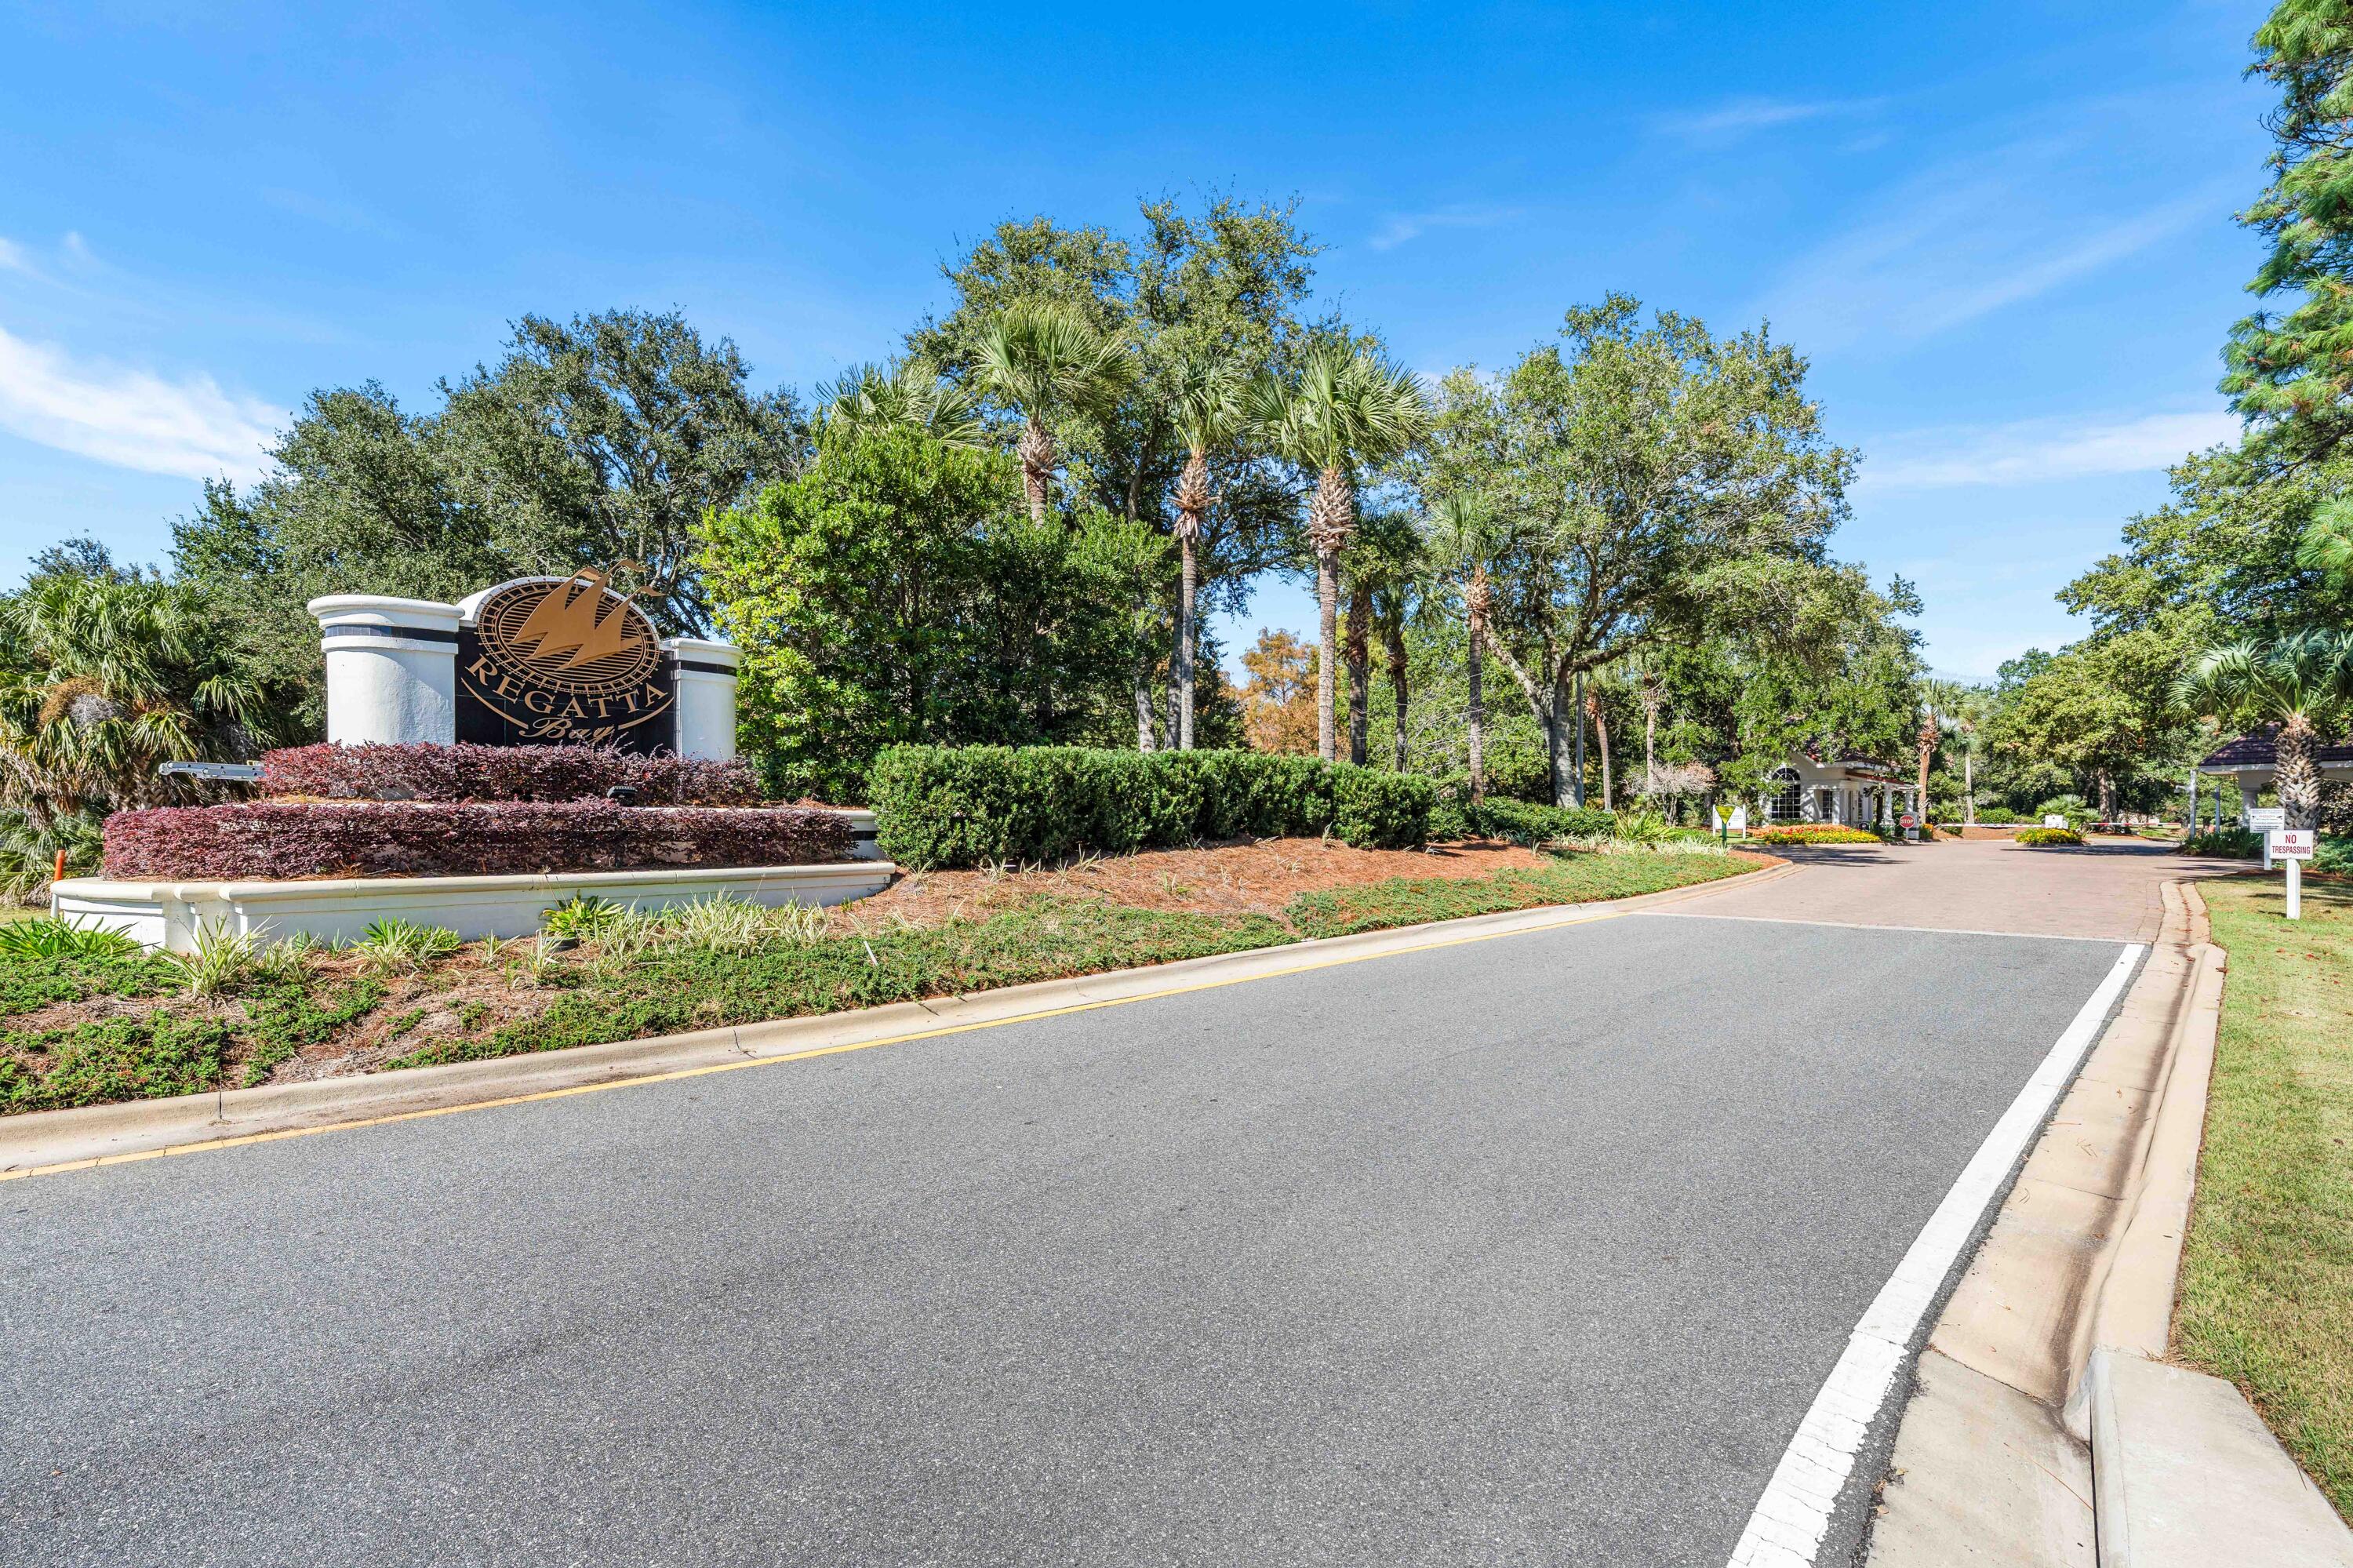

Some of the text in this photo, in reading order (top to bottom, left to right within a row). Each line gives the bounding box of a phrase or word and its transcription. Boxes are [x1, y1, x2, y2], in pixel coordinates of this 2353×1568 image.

[464, 653, 668, 719] REGATTA
[518, 717, 615, 744] Bay
[2285, 835, 2297, 844] NO
[2271, 846, 2311, 854] TRESPASSING
